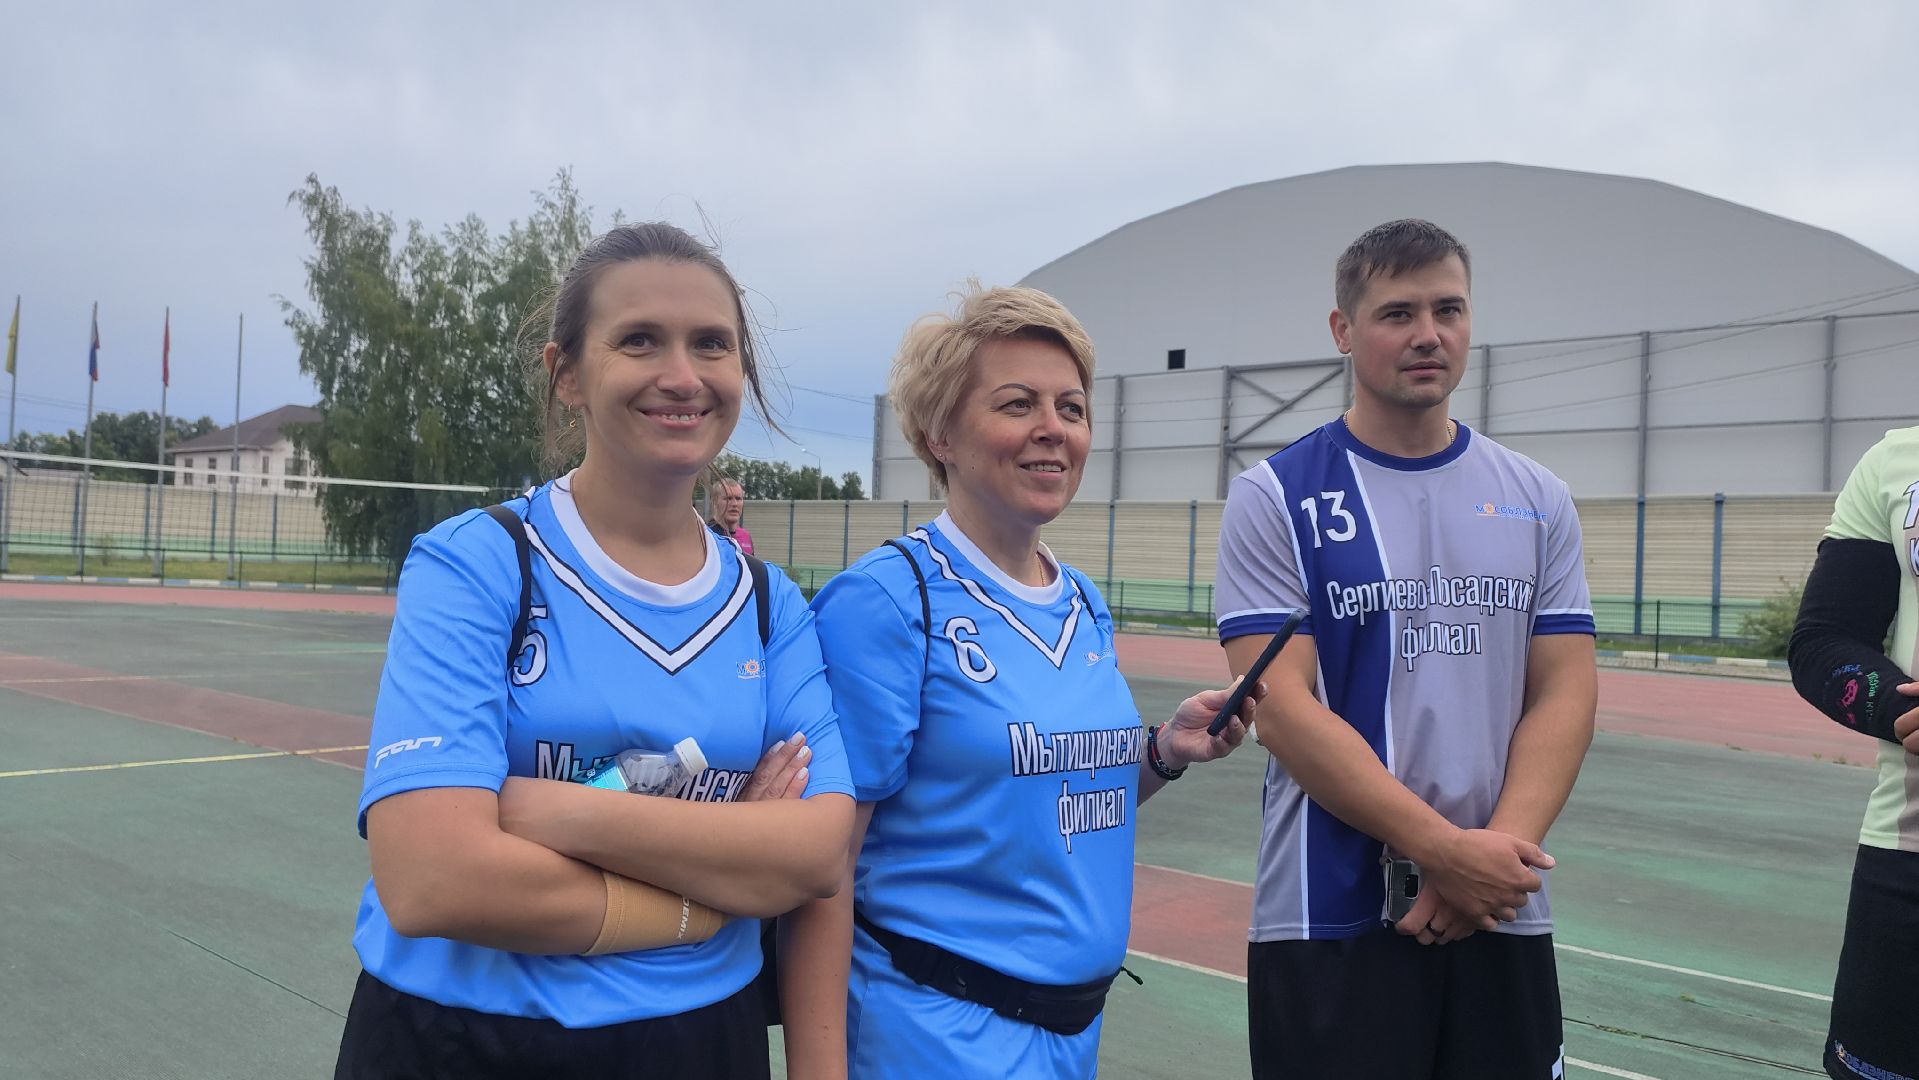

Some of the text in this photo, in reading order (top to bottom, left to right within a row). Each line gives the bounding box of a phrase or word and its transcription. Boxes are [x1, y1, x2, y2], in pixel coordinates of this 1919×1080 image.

[1301, 490, 1357, 548] 13
[511, 604, 548, 687] 5
[944, 616, 998, 683] 6
[1401, 617, 1482, 672] филиал
[1007, 721, 1143, 779] Мытищински
[1057, 780, 1127, 854] филиал
